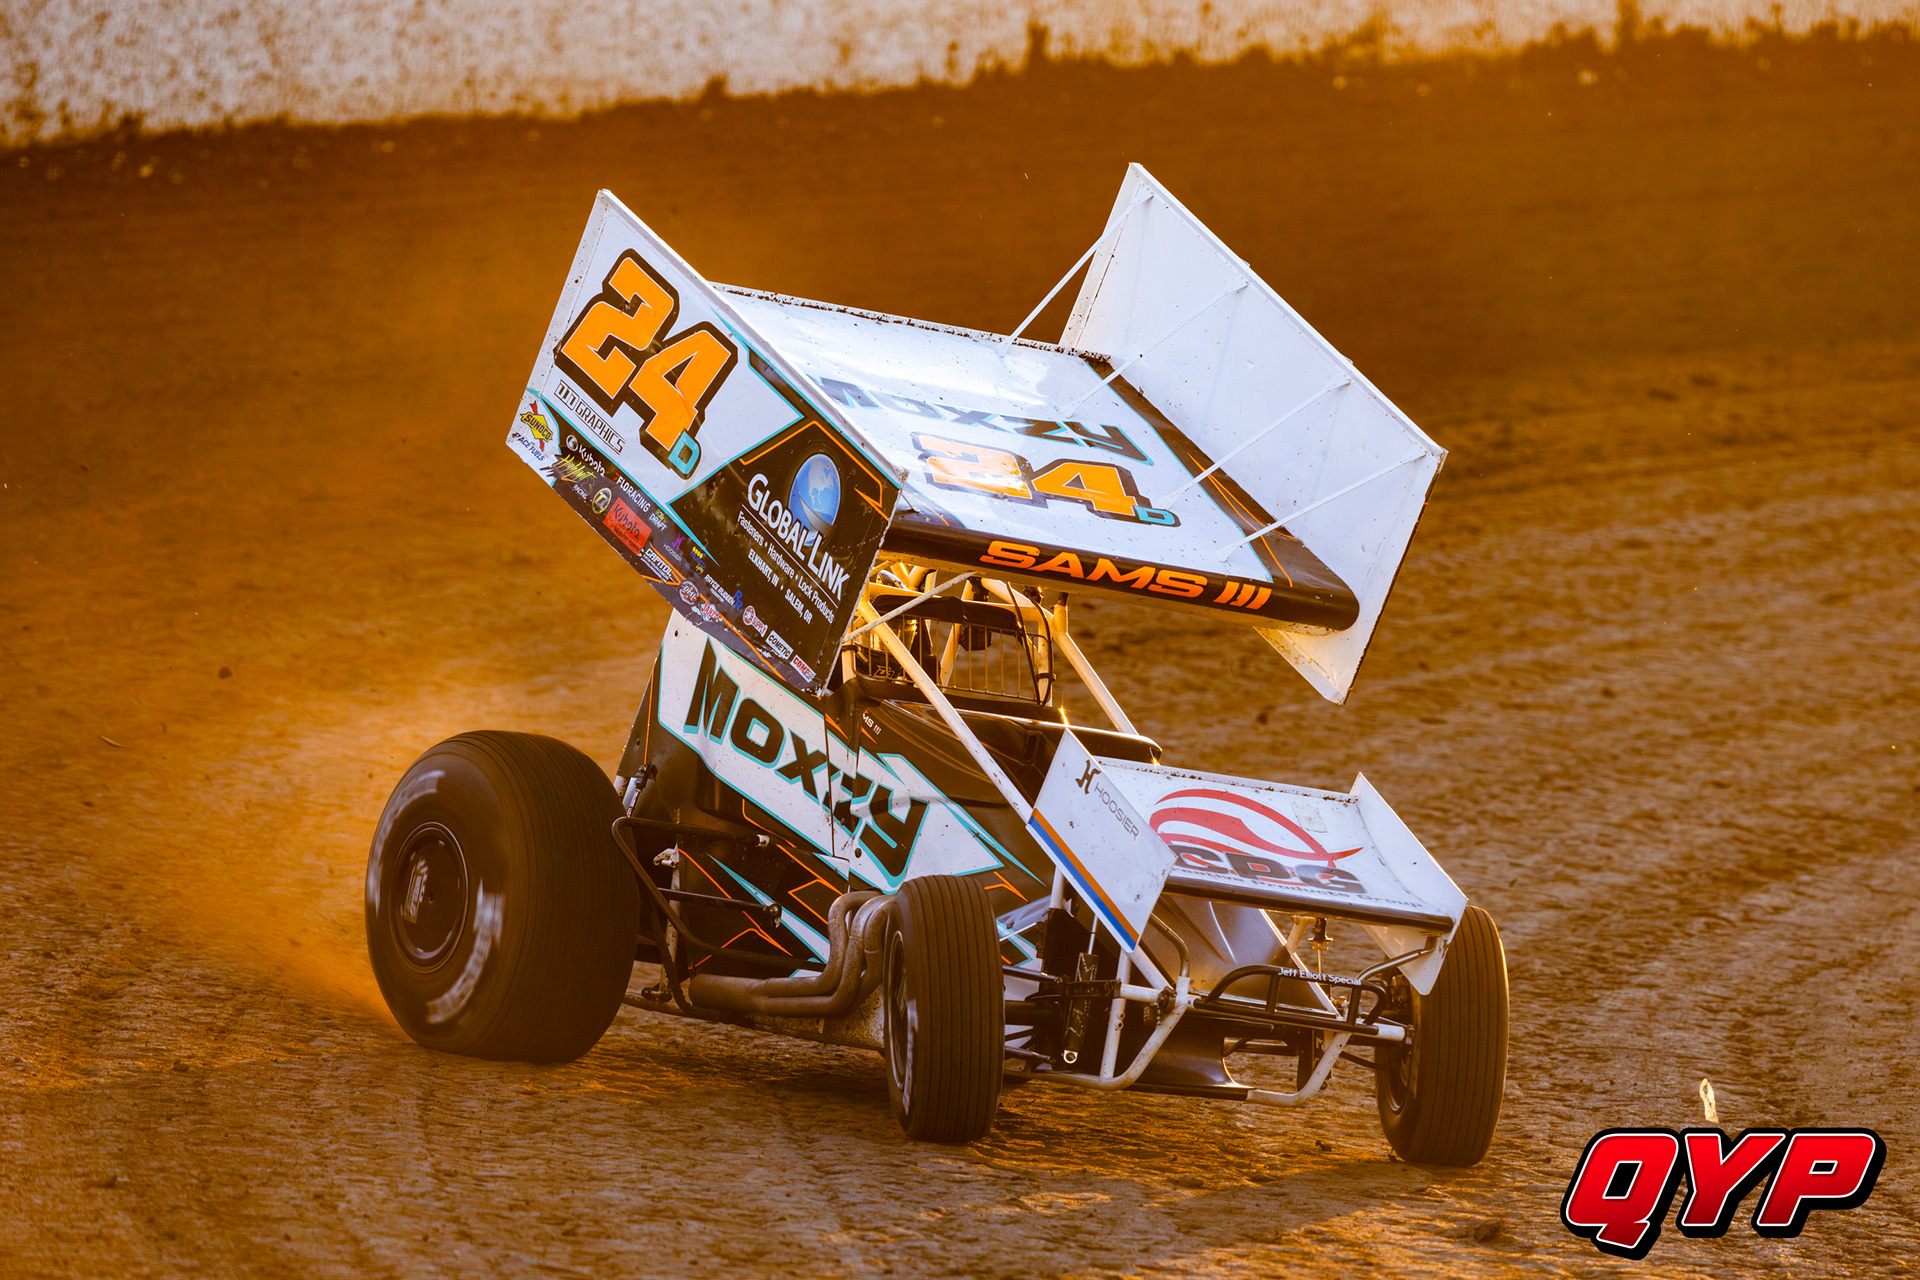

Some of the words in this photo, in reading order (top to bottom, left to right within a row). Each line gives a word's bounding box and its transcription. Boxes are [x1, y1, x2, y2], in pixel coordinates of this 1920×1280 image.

[556, 250, 736, 456] 24
[523, 413, 553, 441] SUNOCO
[575, 401, 625, 455] GRAPHICS
[529, 445, 546, 461] FUELS
[578, 445, 606, 477] Kubota
[911, 431, 1150, 519] 24
[616, 475, 651, 513] FLORACING
[613, 503, 641, 540] Kubota
[748, 473, 808, 561] GLOBAL
[808, 533, 850, 601] LINK
[645, 548, 672, 577] CAPITOL
[737, 511, 765, 547] Fasteners
[767, 543, 795, 579] Hardware
[798, 575, 814, 600] Lock
[811, 590, 835, 624] Products
[980, 540, 1208, 599] SAMS
[1213, 581, 1272, 611] III
[771, 573, 780, 587] IN
[784, 588, 805, 617] SALEM,
[803, 609, 813, 624] OR
[768, 634, 792, 658] COMETIC
[1094, 782, 1140, 840] HOOSIER
[1278, 967, 1298, 978] Jeff
[1328, 974, 1362, 986] Special
